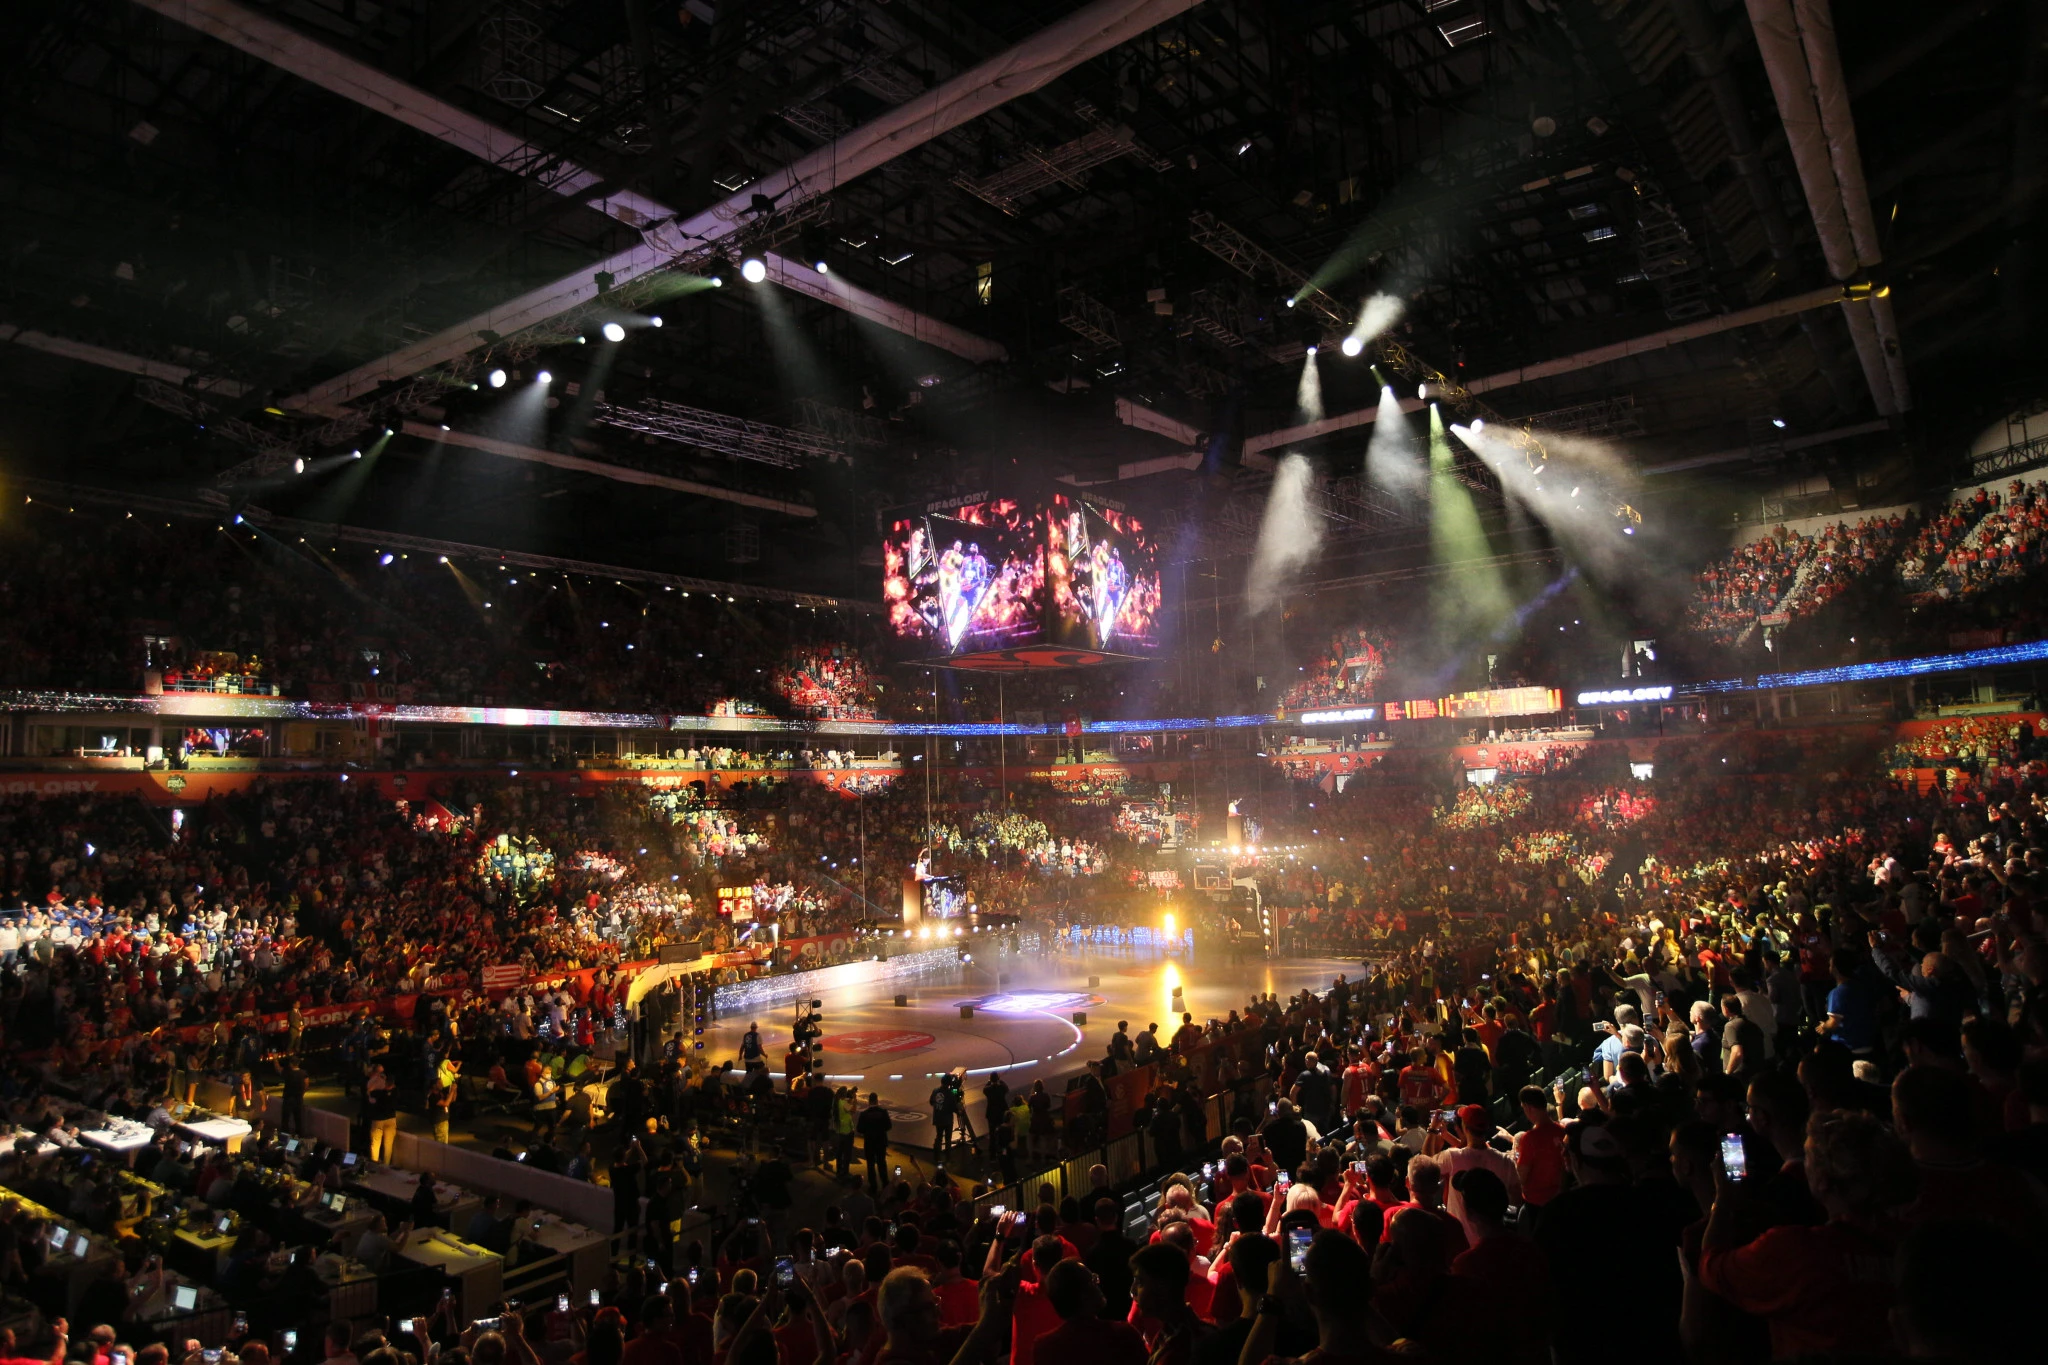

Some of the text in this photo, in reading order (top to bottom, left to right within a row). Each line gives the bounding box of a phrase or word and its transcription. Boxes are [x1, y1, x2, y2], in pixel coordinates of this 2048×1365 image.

[926, 490, 989, 513] #F4GLORY
[720, 898, 752, 913] 24 24
